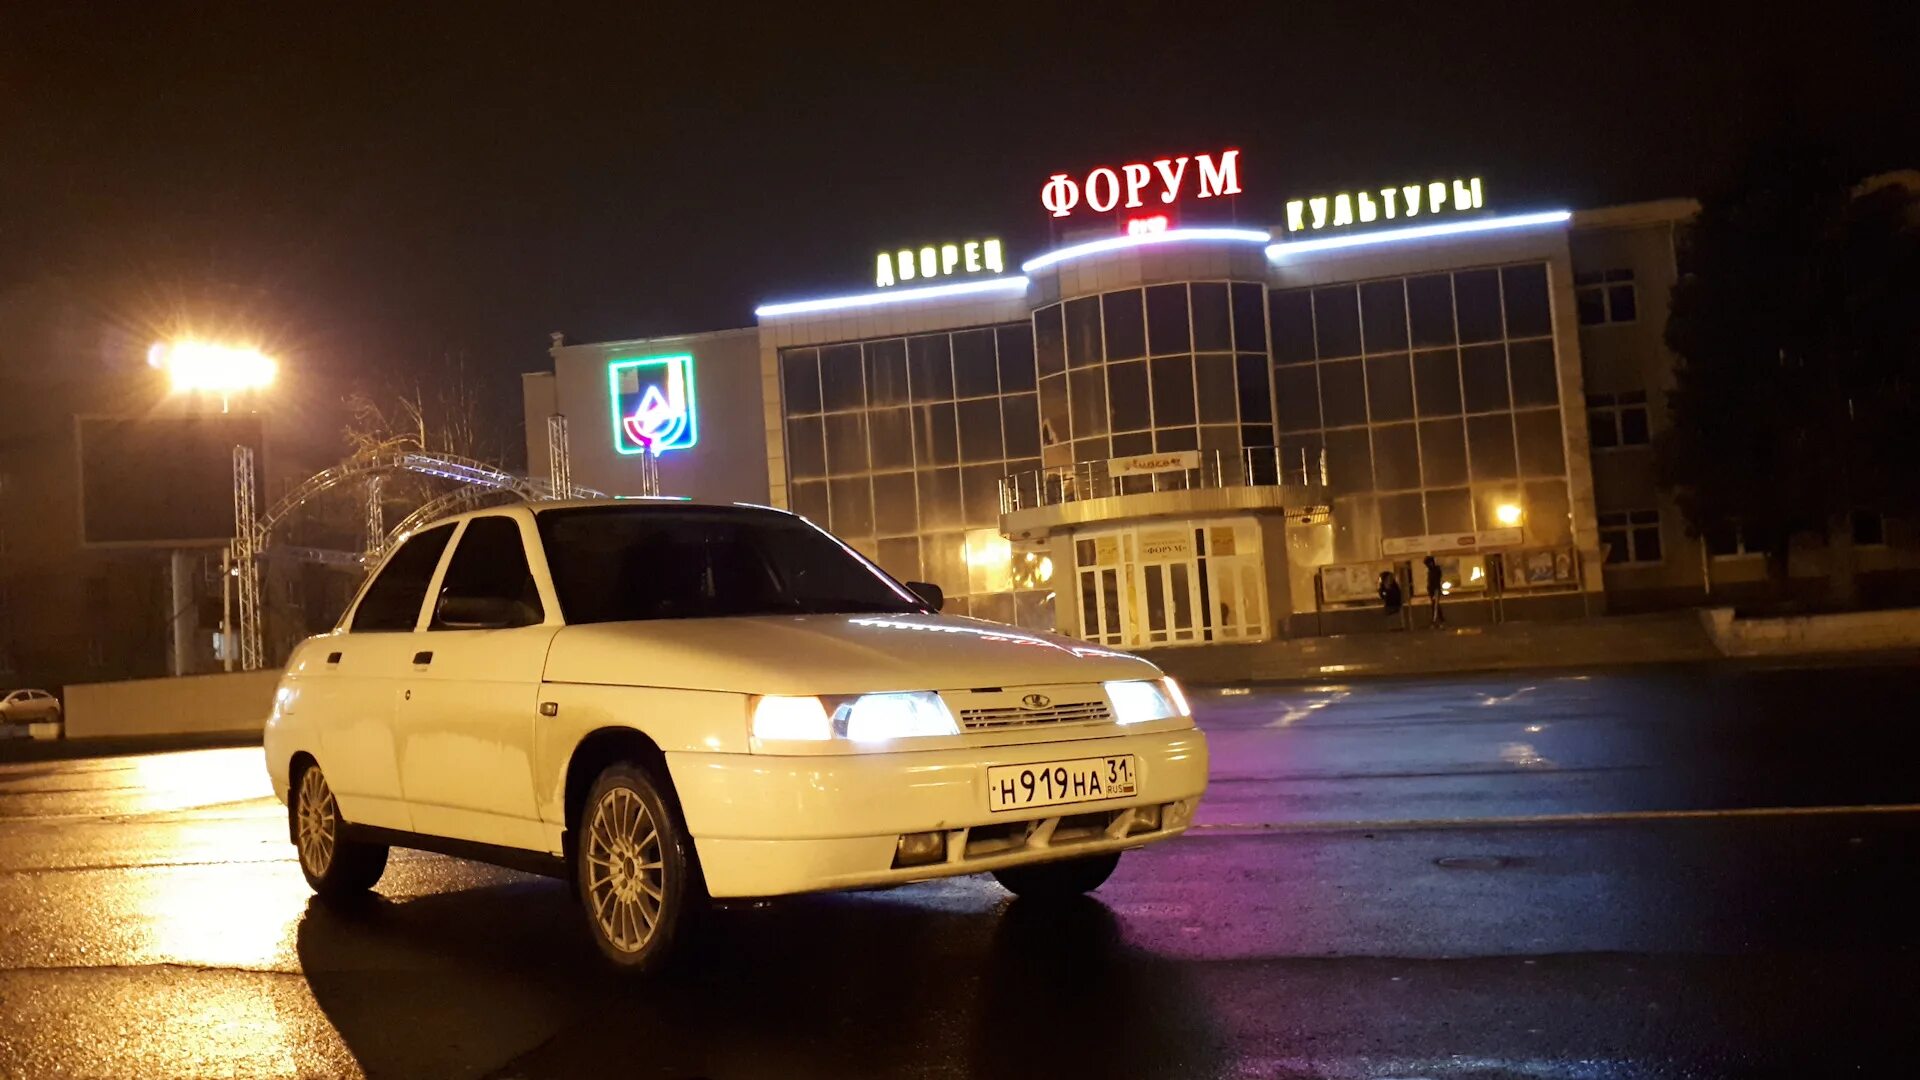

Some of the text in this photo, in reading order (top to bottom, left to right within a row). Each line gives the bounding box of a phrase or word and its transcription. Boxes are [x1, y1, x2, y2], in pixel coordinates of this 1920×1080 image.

[1041, 150, 1241, 217] ФОРУМ
[1286, 177, 1482, 231] КУЛЬТУРЫ
[876, 239, 1003, 288] ДВОРЕЦ
